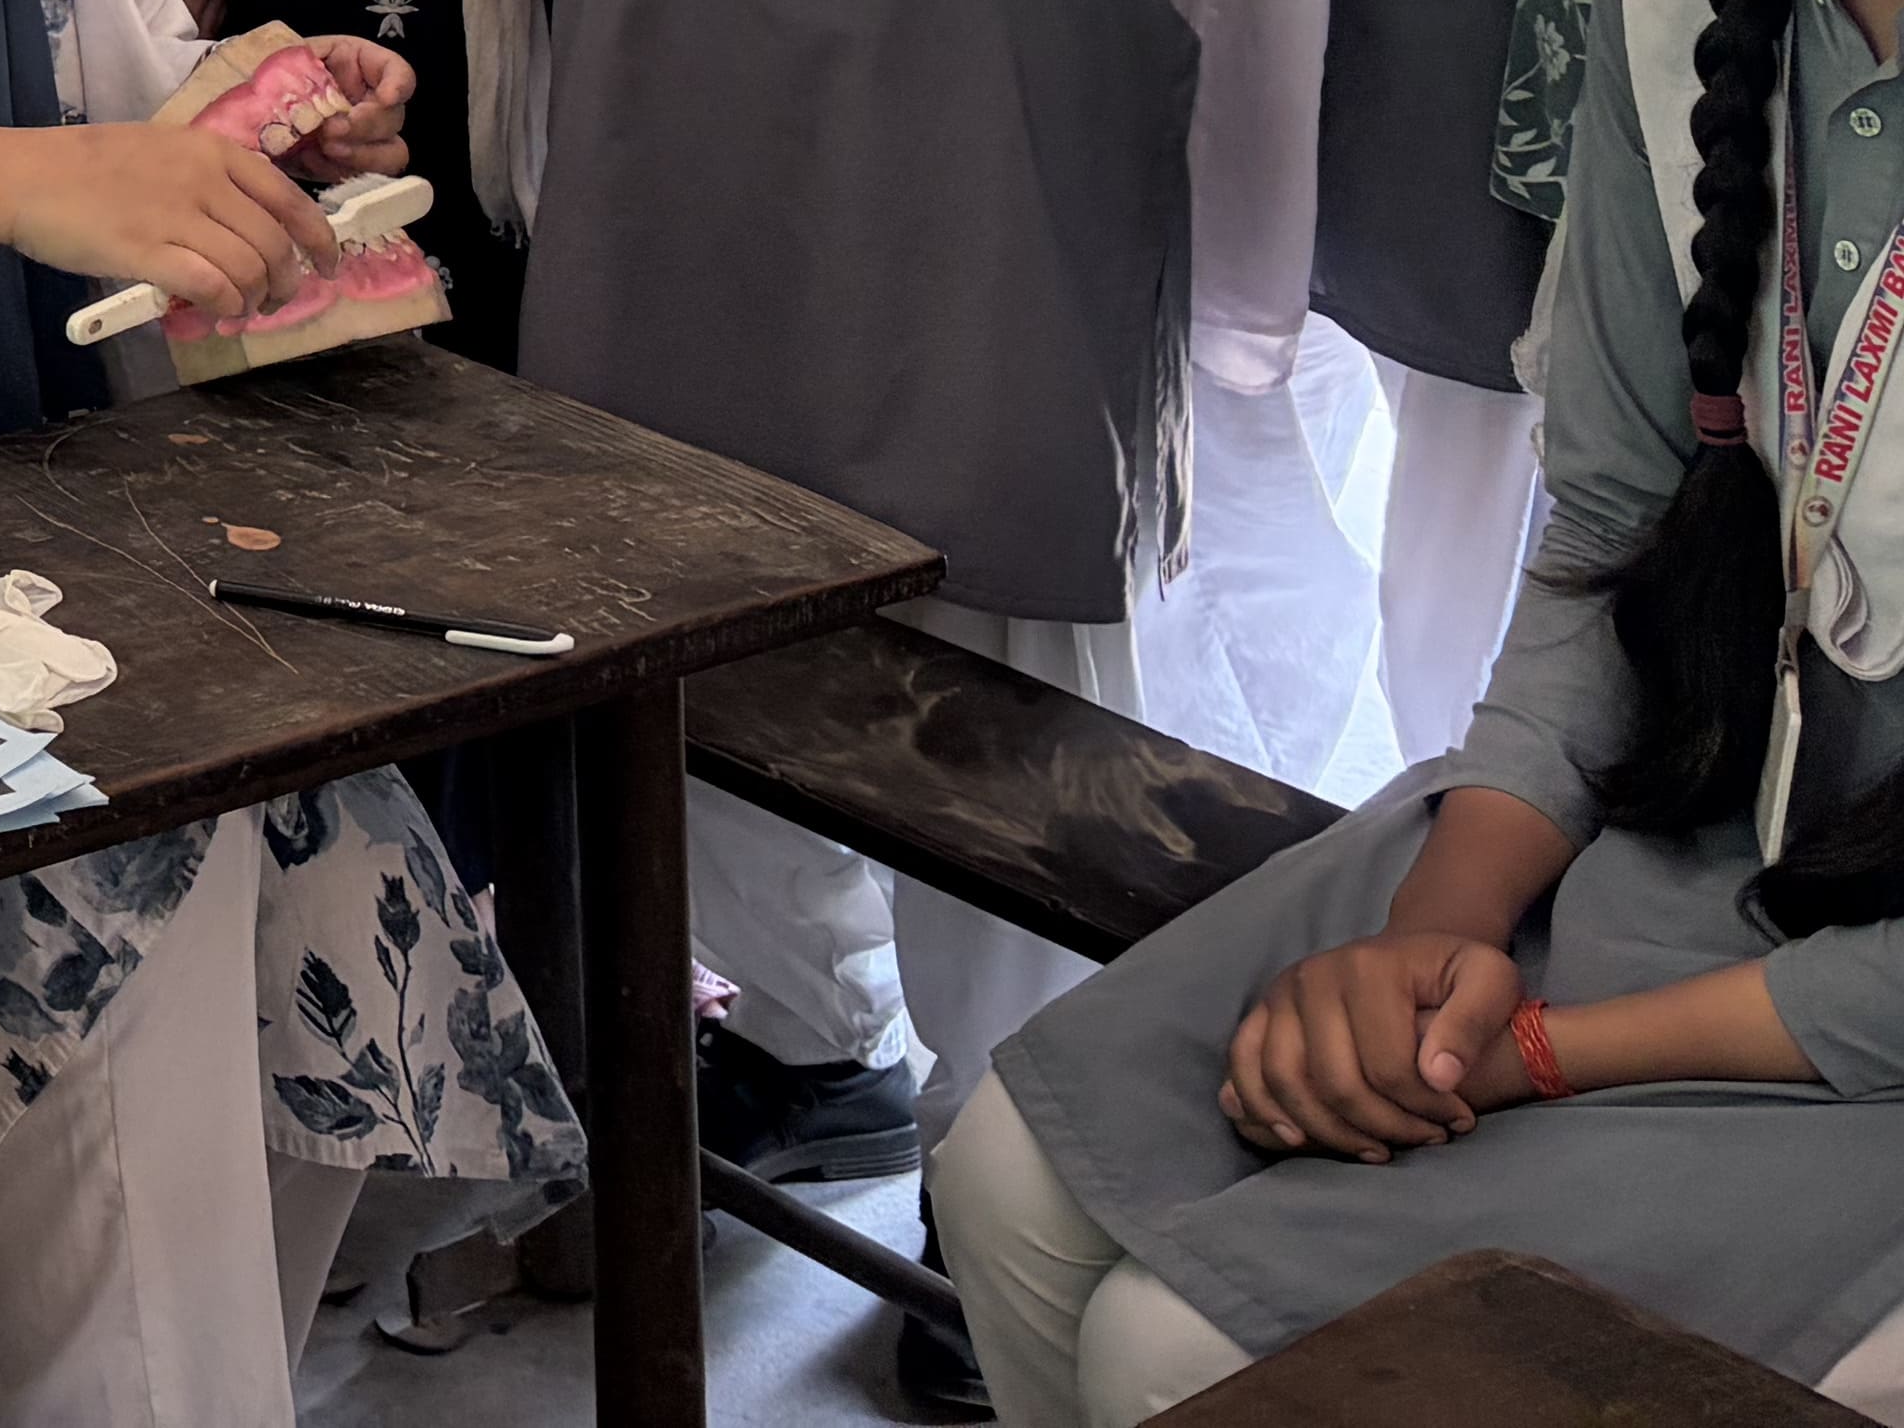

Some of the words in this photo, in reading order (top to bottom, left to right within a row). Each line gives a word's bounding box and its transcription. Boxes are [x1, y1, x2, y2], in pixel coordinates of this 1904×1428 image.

[1784, 326, 1807, 415] RANI
[1814, 403, 1864, 483] RANI
[1844, 298, 1899, 404] LAXMI
